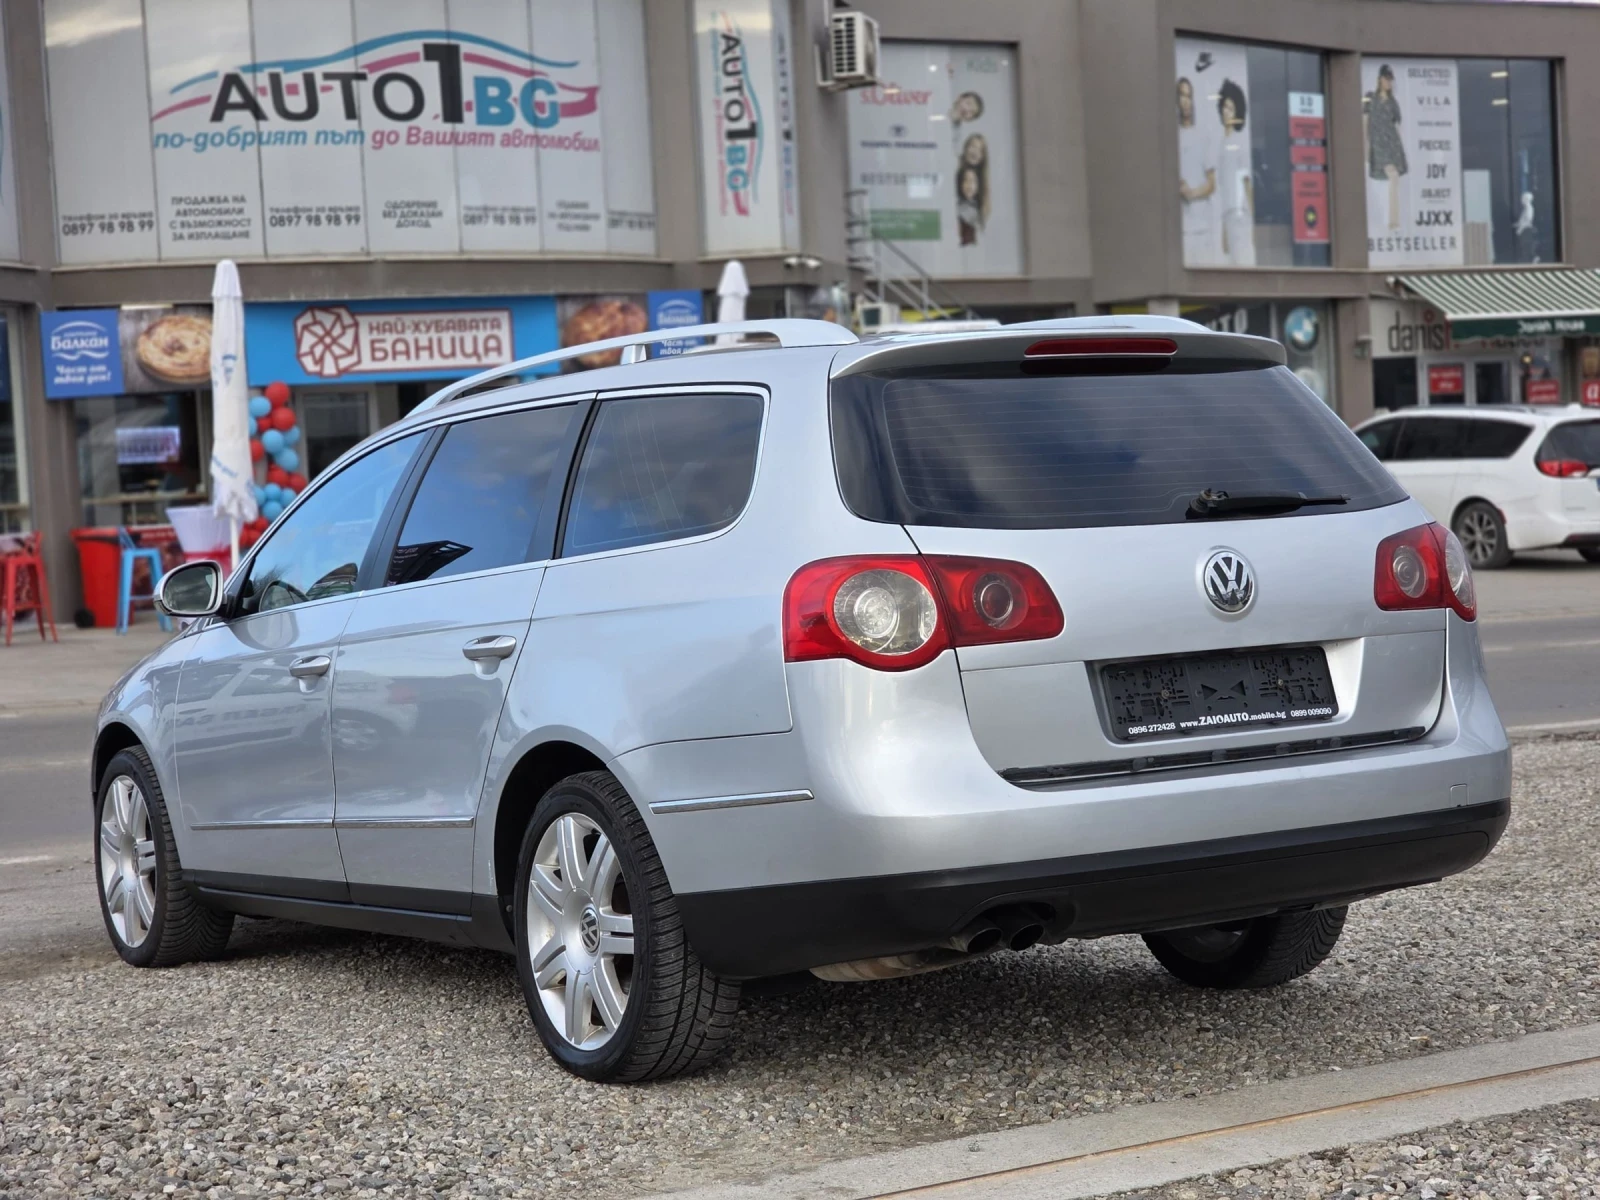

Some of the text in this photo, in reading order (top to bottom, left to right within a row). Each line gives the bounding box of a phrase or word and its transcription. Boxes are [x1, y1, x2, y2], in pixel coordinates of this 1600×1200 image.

[209, 42, 561, 129] AUTO1BG
[1416, 95, 1451, 106] VILA
[154, 125, 307, 153] по-добрият
[315, 128, 365, 146] път
[371, 129, 400, 151] до
[405, 125, 495, 147] Вашият
[171, 194, 247, 206] ПРОДАЖБА НА
[175, 206, 245, 218] АВТОМОБИЛИ
[269, 213, 361, 227] 0897 98 98 99
[1415, 210, 1453, 226] JJXX
[62, 218, 155, 236] 0897 98 98 99
[172, 231, 185, 242] ЗА
[1367, 235, 1457, 252] BESTSELLER
[369, 316, 501, 335] НАЙ-ХУБАВАТА
[1206, 308, 1248, 334] UTO
[51, 335, 109, 351] Балкан
[369, 334, 504, 362] БАНИЦА
[1203, 550, 1255, 613] VW
[1128, 726, 1148, 735] 0896
[1148, 722, 1176, 733] 272428
[1290, 709, 1308, 718] 0899
[1308, 707, 1332, 717] 009090
